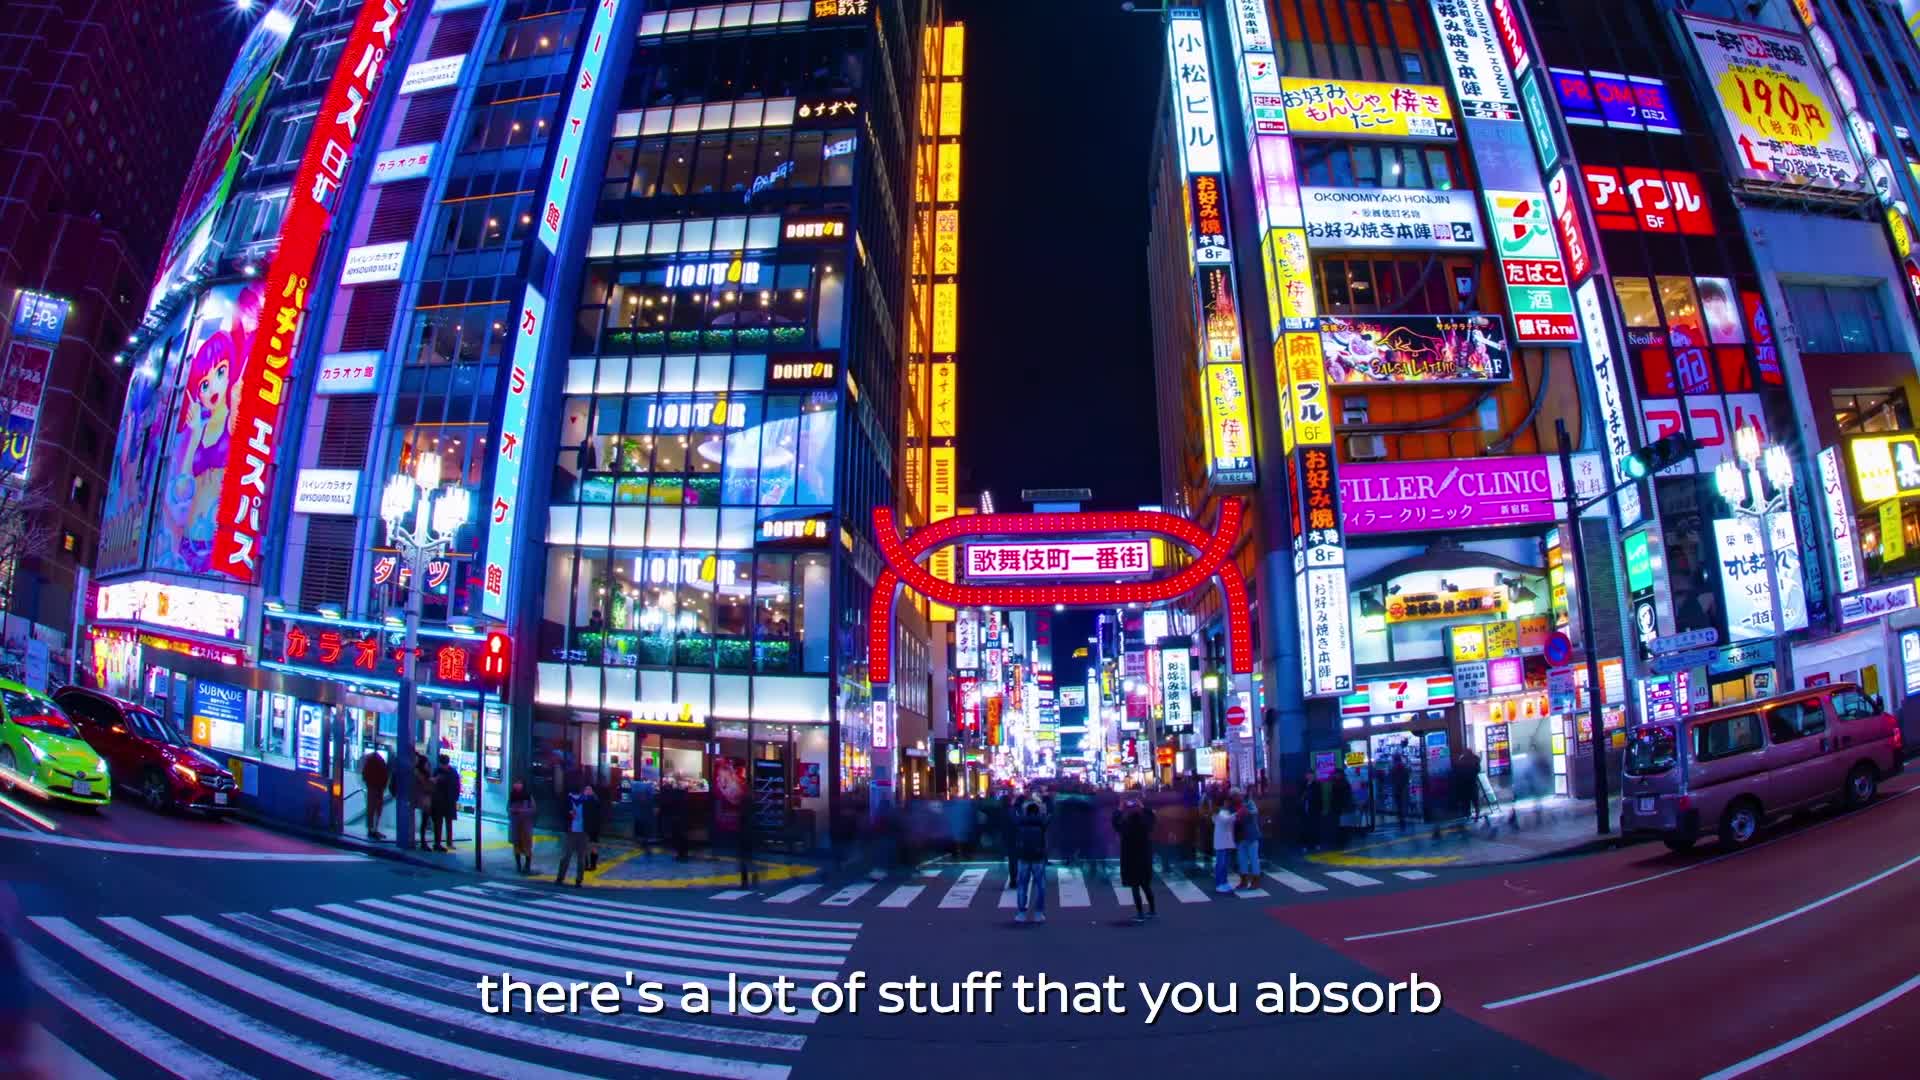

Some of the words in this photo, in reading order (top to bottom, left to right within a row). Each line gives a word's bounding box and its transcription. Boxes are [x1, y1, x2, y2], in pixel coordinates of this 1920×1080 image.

[838, 6, 868, 16] BAR
[1178, 33, 1214, 148] 小松ビル
[1283, 84, 1346, 108] お好み
[1391, 88, 1440, 113] 焼き
[1561, 79, 1664, 108] PROMISE
[1306, 94, 1381, 122] もんじゃ
[1627, 107, 1668, 121] プロミス
[1437, 122, 1454, 137] 7F
[1313, 192, 1402, 203] OKONOMIYAKI
[1403, 194, 1450, 204] HONJIN
[1587, 173, 1701, 213] アイフル
[1307, 222, 1432, 240] お好み焼き本陣
[1646, 214, 1665, 228] 5F
[1453, 224, 1472, 239] 2F
[1205, 249, 1223, 260] 8F
[1507, 263, 1562, 283] たばこ
[1527, 289, 1553, 310] 酒
[1519, 318, 1575, 336] 銀行ATM
[259, 273, 308, 406] パチンコ
[321, 366, 374, 380] カラオケ館
[1371, 358, 1410, 375] SALSA
[1483, 359, 1503, 374] 4F
[1304, 426, 1321, 440] 6F
[486, 308, 537, 596] カラオケ館
[228, 417, 273, 570] エスパス
[1305, 450, 1334, 529] お好み焼
[1340, 476, 1435, 503] FILLER
[1458, 469, 1549, 497] CLINIC
[1400, 504, 1473, 524] クリニック
[973, 546, 1143, 572] 歌舞伎町一番街
[1314, 548, 1336, 562] 8F
[374, 557, 450, 588] ダーツ
[1745, 578, 1785, 596] SUSI
[1314, 583, 1331, 678] お好み焼き本陣
[199, 682, 244, 702] SUBNADE
[302, 706, 312, 727] P
[197, 721, 206, 740] 3
